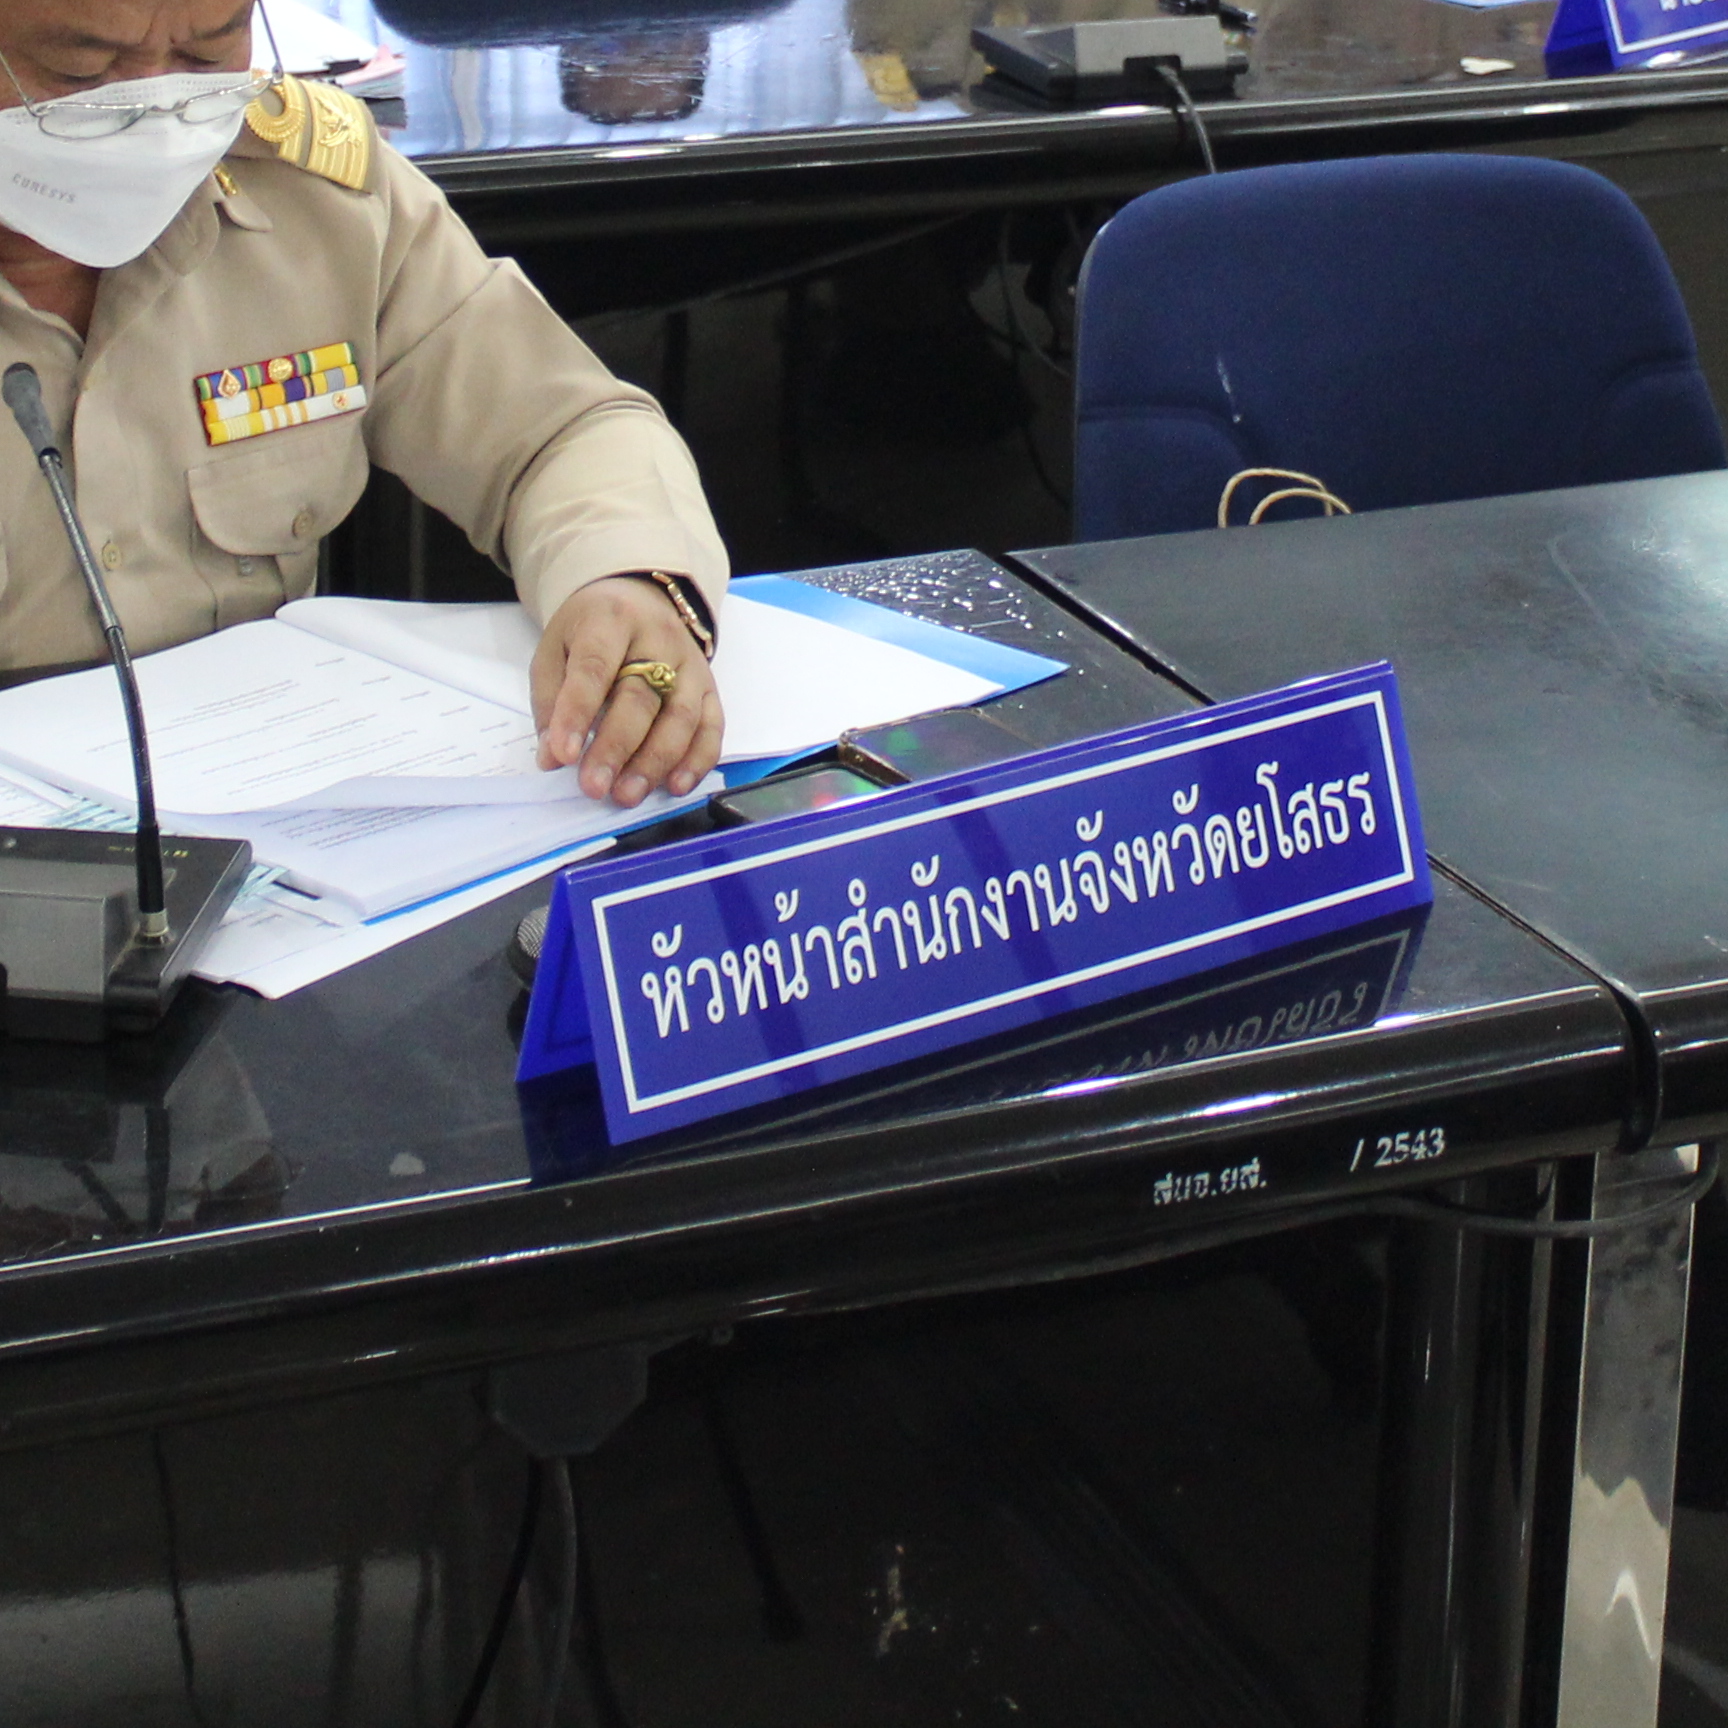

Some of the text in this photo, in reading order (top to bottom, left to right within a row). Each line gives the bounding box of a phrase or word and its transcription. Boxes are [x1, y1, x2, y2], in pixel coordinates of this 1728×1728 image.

[640, 760, 1377, 1039] หัวหน้าสำนักงานจังหวัดยโสธร
[1374, 1127, 1445, 1167] 2543
